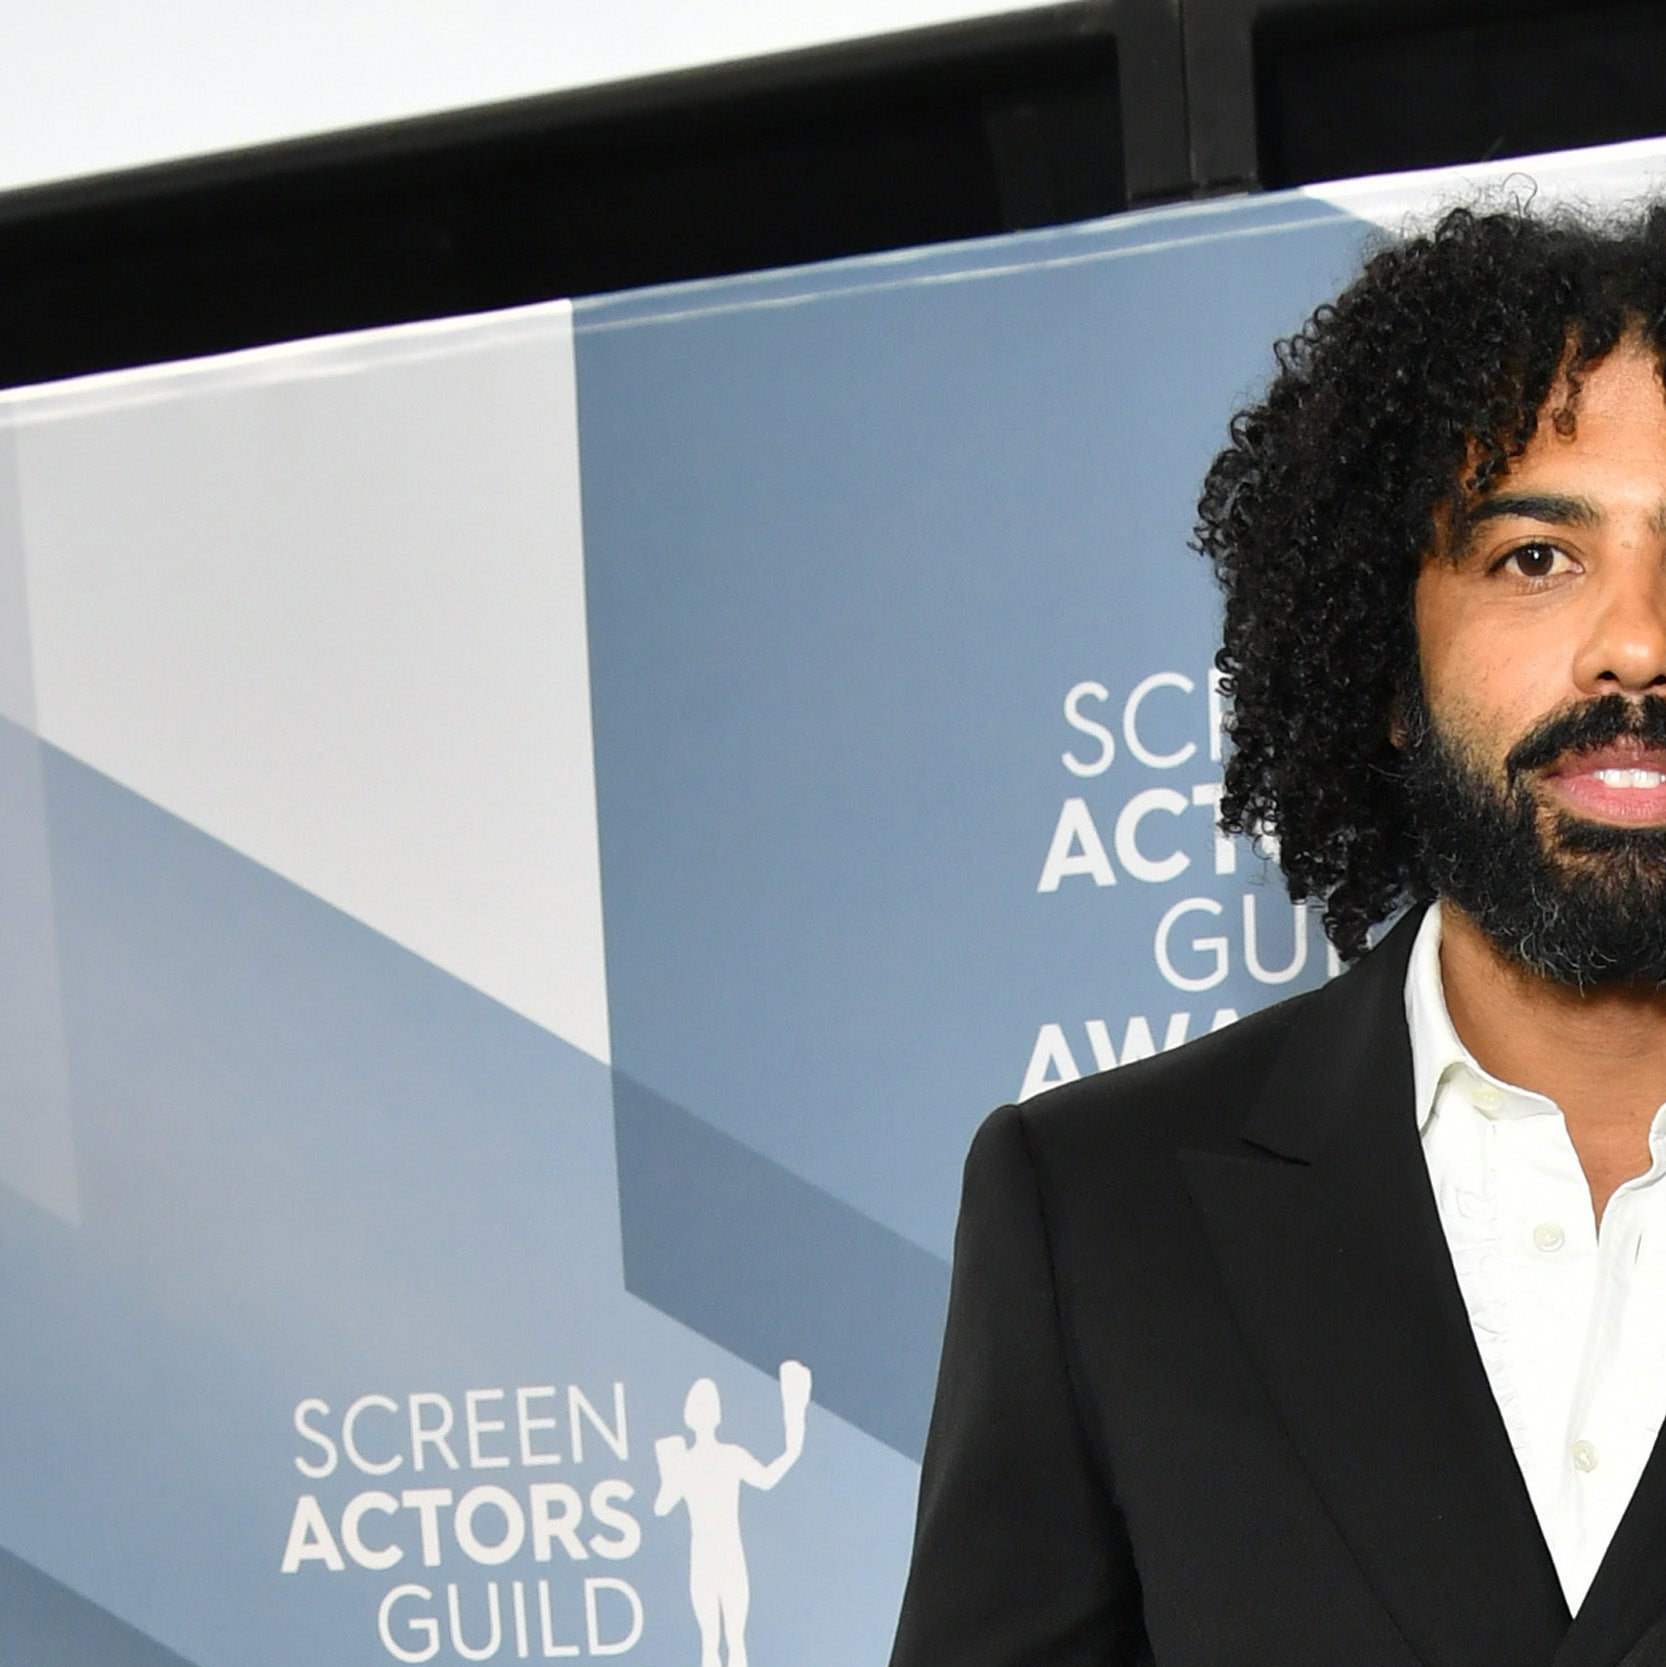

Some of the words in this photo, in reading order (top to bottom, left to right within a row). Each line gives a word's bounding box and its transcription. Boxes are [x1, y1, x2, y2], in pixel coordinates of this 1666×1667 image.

[1037, 782, 1282, 893] ACT
[294, 1382, 629, 1478] SCREEN
[281, 1480, 641, 1573] ACTORS
[378, 1577, 644, 1663] GUILD
